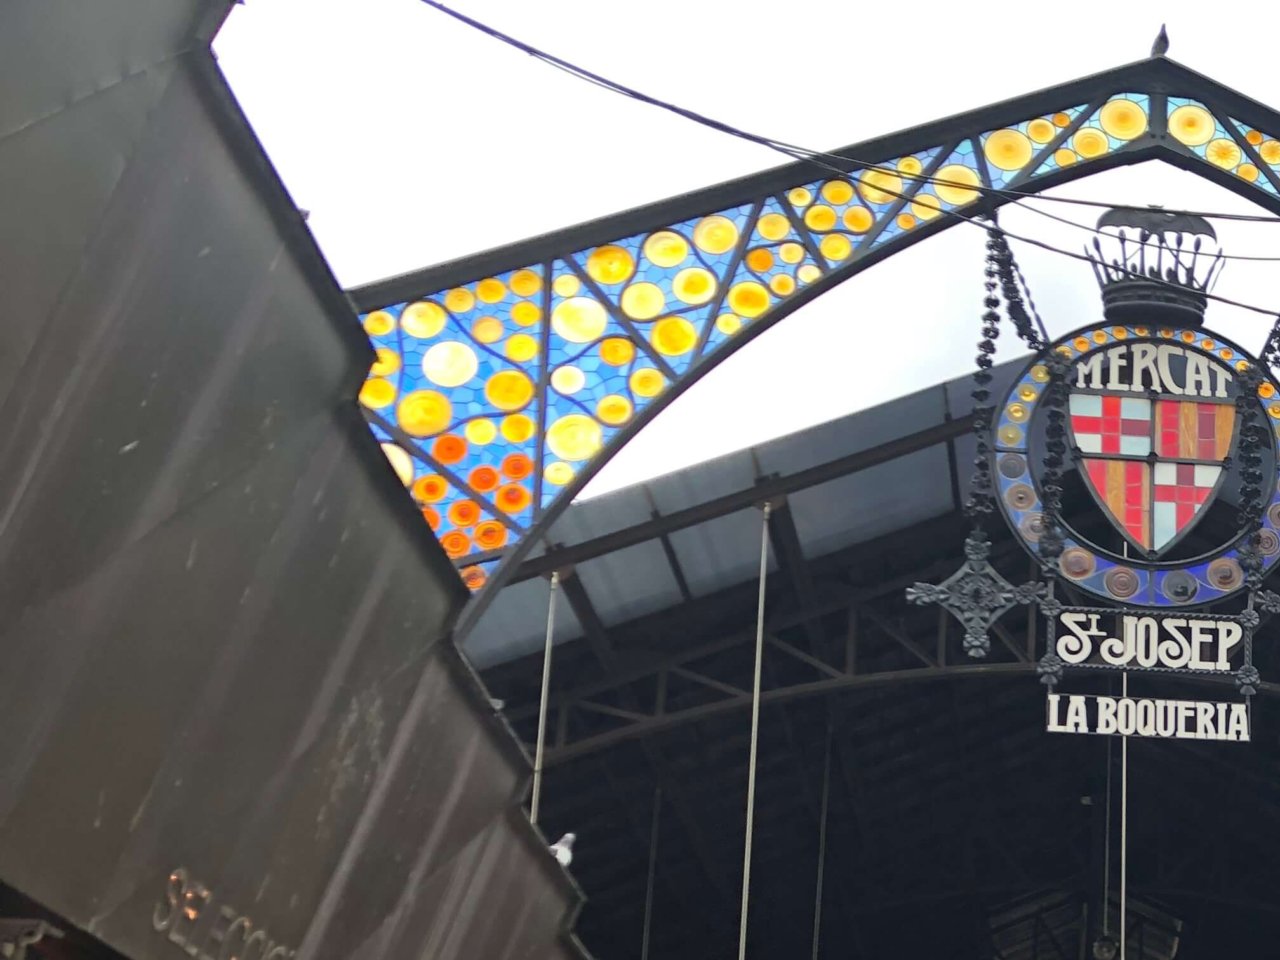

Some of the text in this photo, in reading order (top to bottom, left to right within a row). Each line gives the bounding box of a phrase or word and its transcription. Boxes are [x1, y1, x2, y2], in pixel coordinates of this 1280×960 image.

[1076, 343, 1233, 398] MERCAT
[1100, 615, 1243, 671] JOSEP
[1047, 694, 1250, 741] LA BOQUERIA
